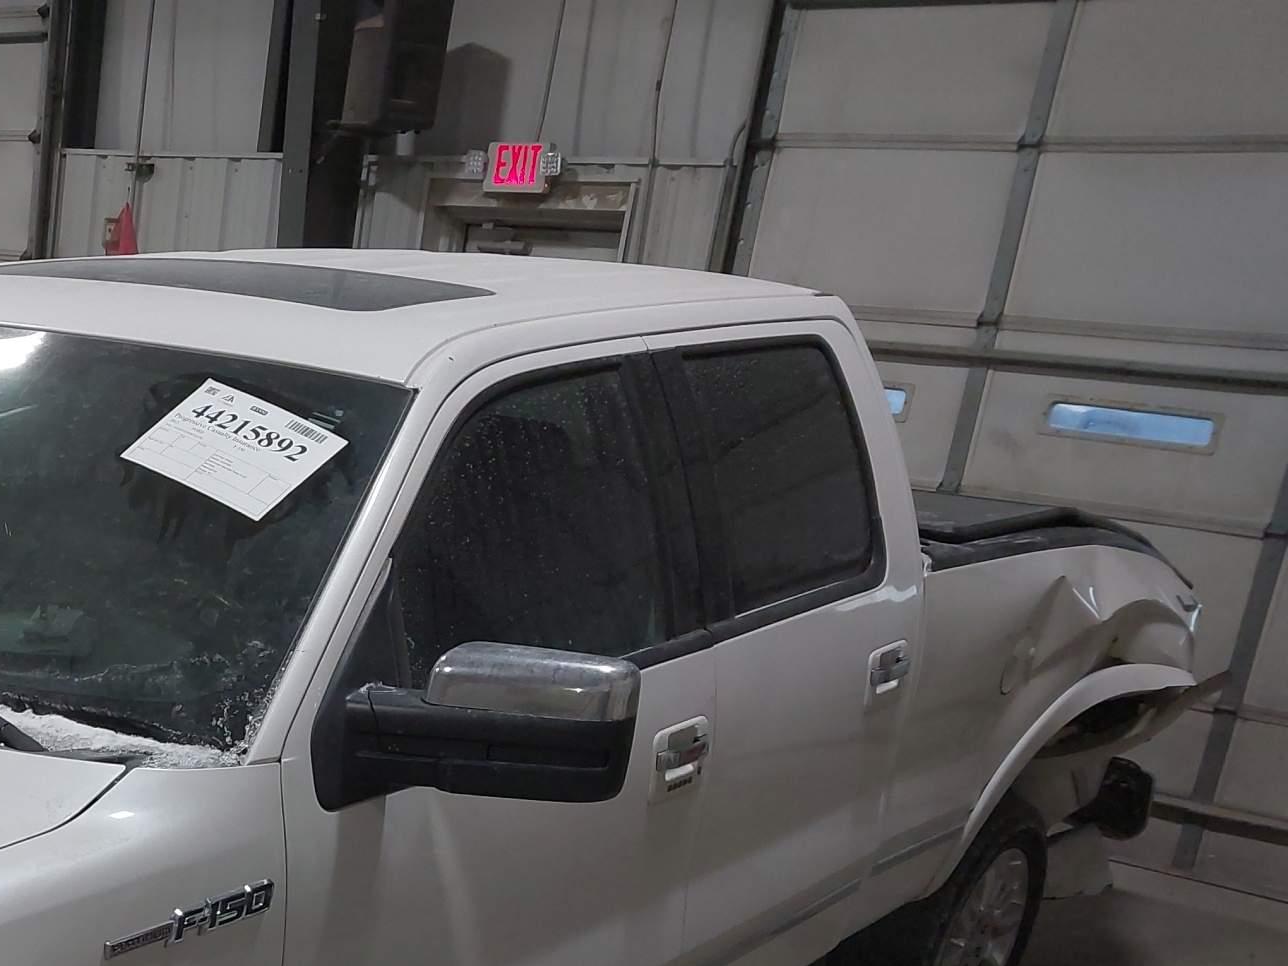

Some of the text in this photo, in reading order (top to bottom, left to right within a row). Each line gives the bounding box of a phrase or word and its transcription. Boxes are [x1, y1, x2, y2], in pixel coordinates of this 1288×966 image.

[493, 144, 542, 186] EXIT
[191, 404, 308, 462] 44215892
[207, 425, 232, 440] Casualty
[169, 879, 275, 943] F-150
